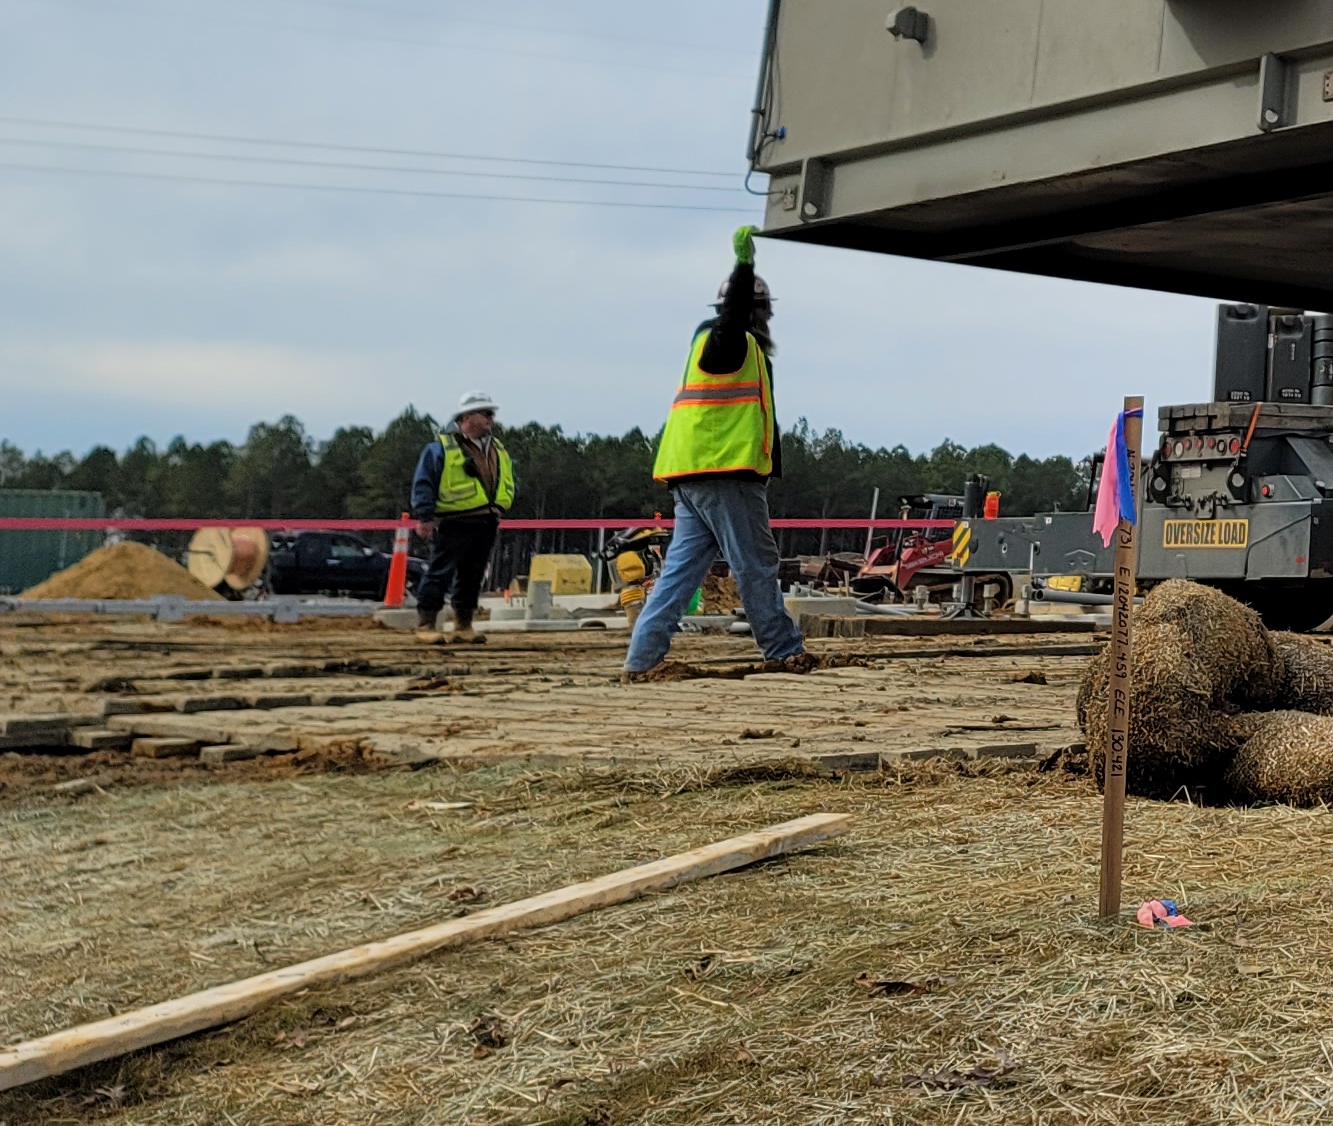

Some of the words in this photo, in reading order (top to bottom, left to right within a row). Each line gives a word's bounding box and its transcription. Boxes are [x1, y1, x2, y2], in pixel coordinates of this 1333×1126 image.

[1165, 522, 1216, 545] OVERSIZE
[1218, 521, 1246, 545] LOAD
[1110, 728, 1124, 777] 130.421
